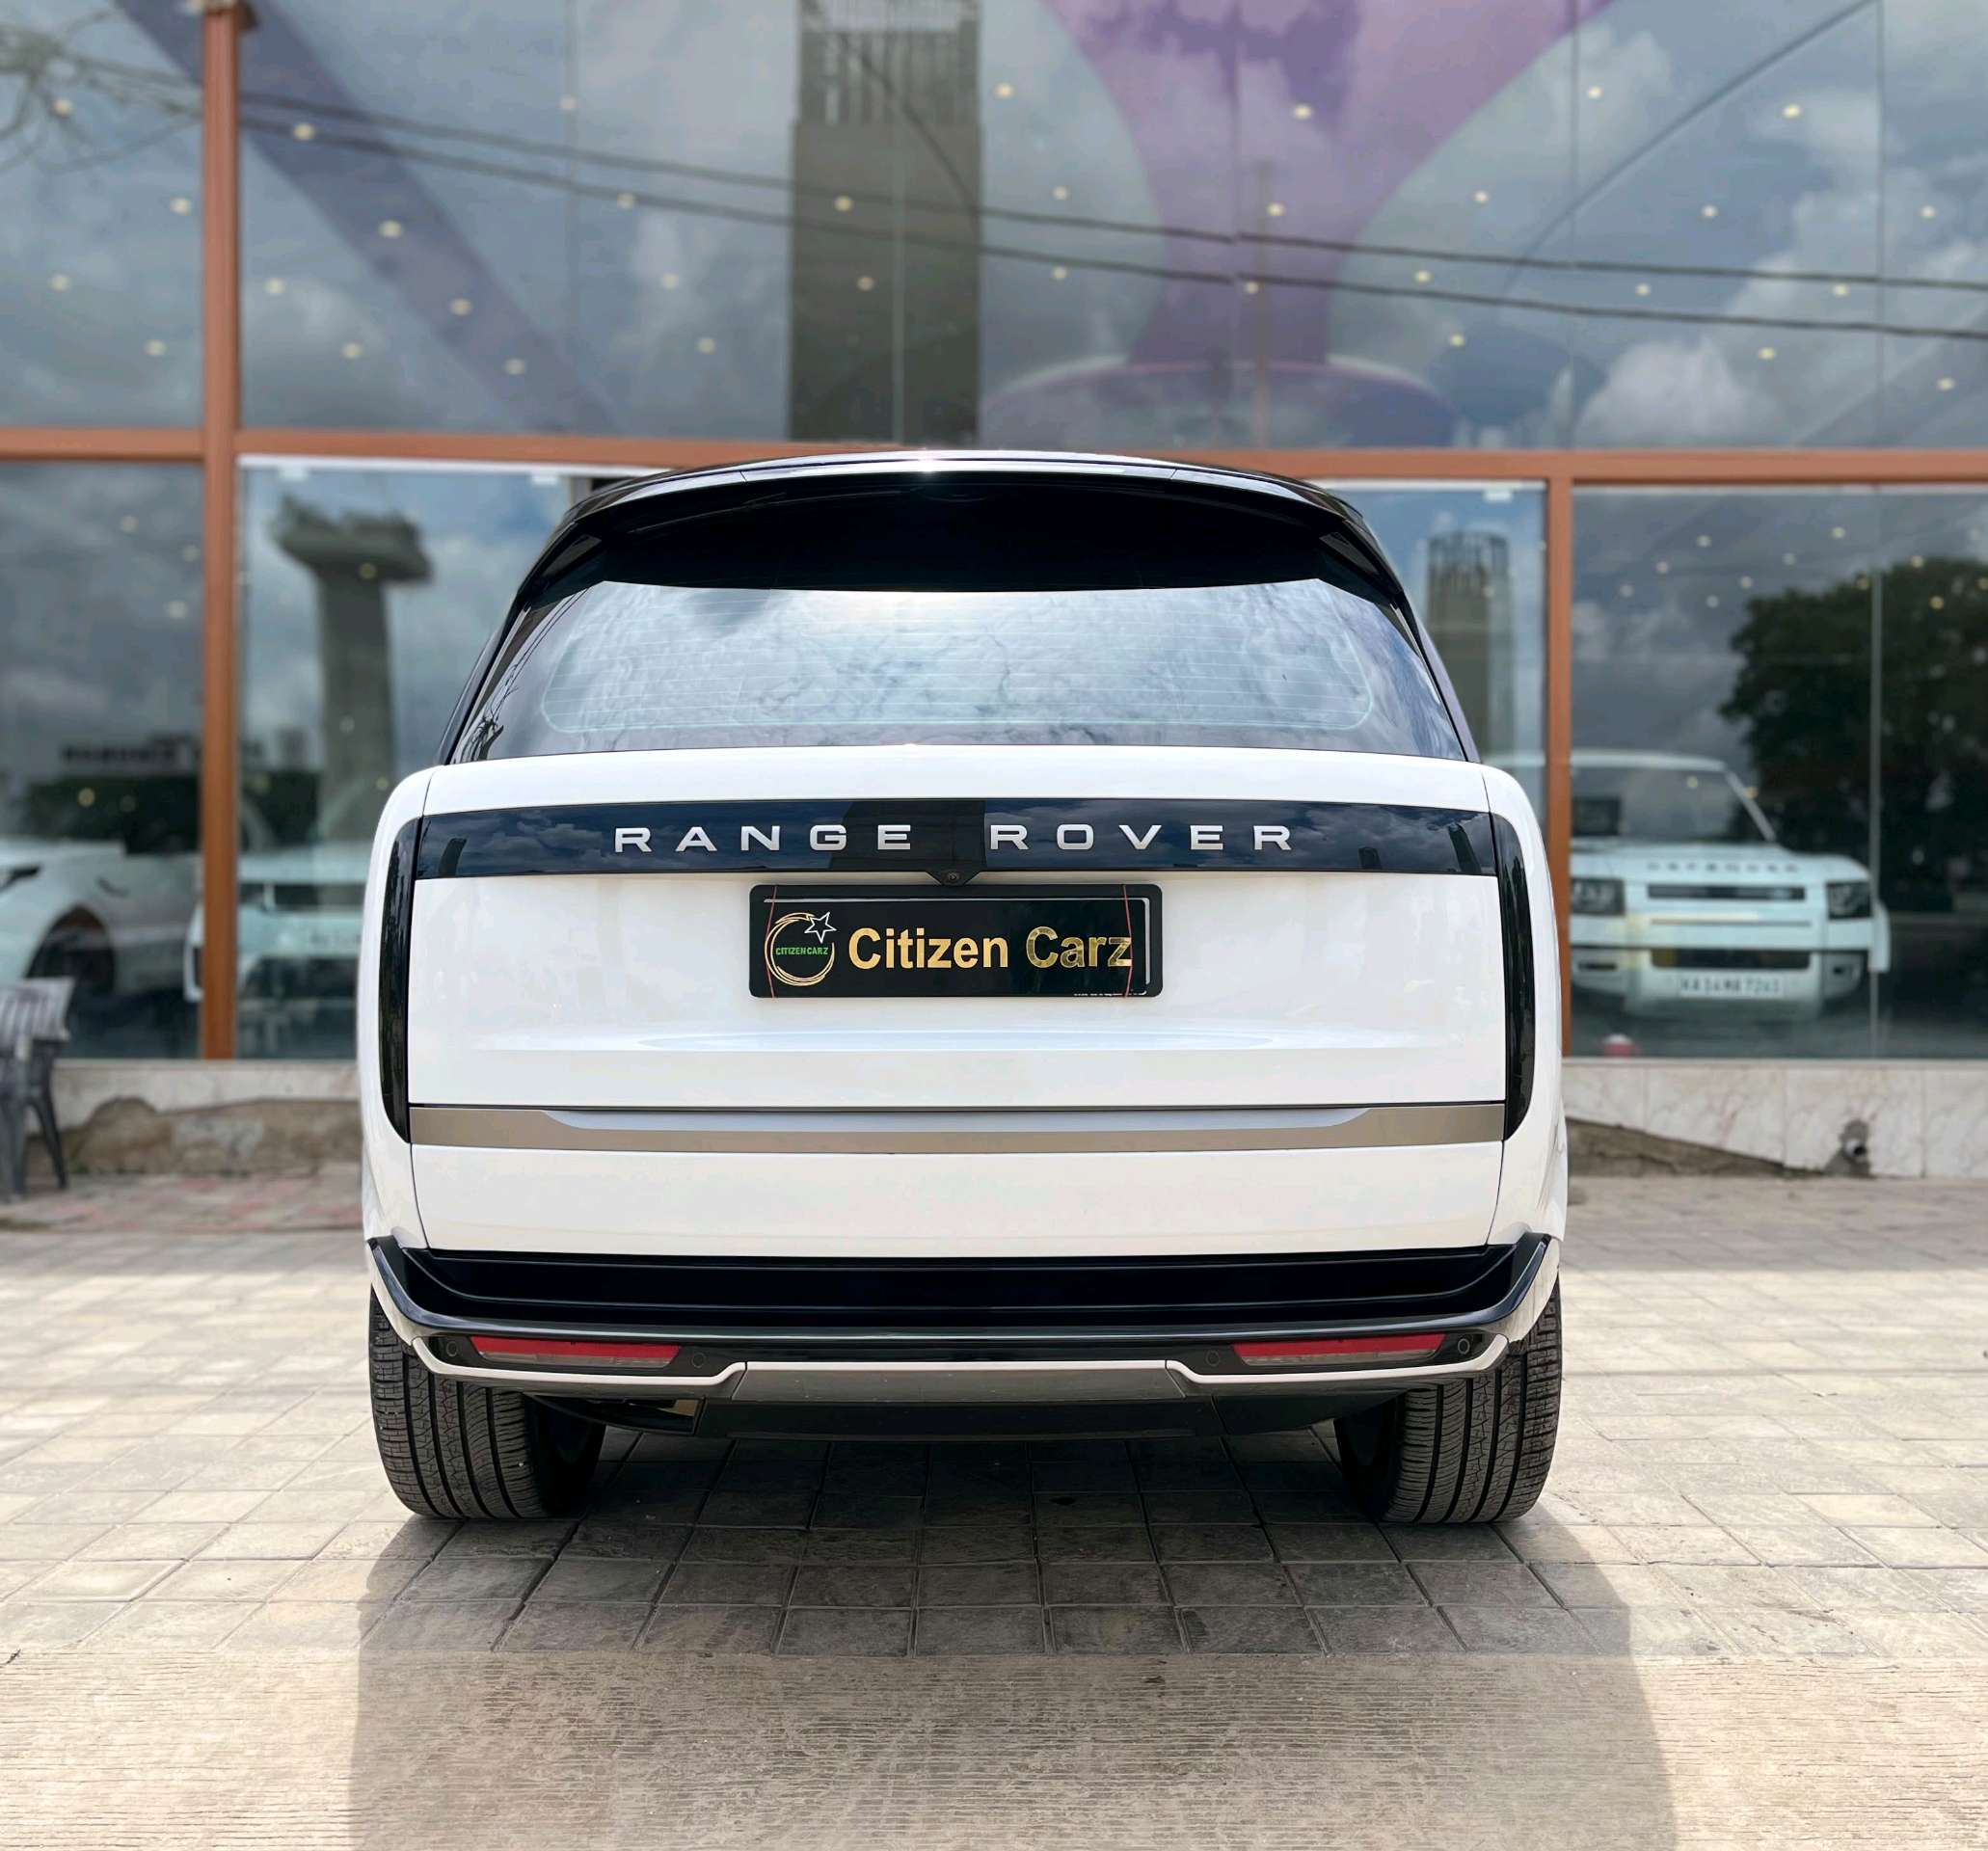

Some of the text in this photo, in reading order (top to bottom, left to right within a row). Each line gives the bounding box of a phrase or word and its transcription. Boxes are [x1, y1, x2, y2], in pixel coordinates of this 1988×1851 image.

[614, 824, 1292, 853] RANGE ROVER
[848, 926, 1132, 969] Citizen Carz
